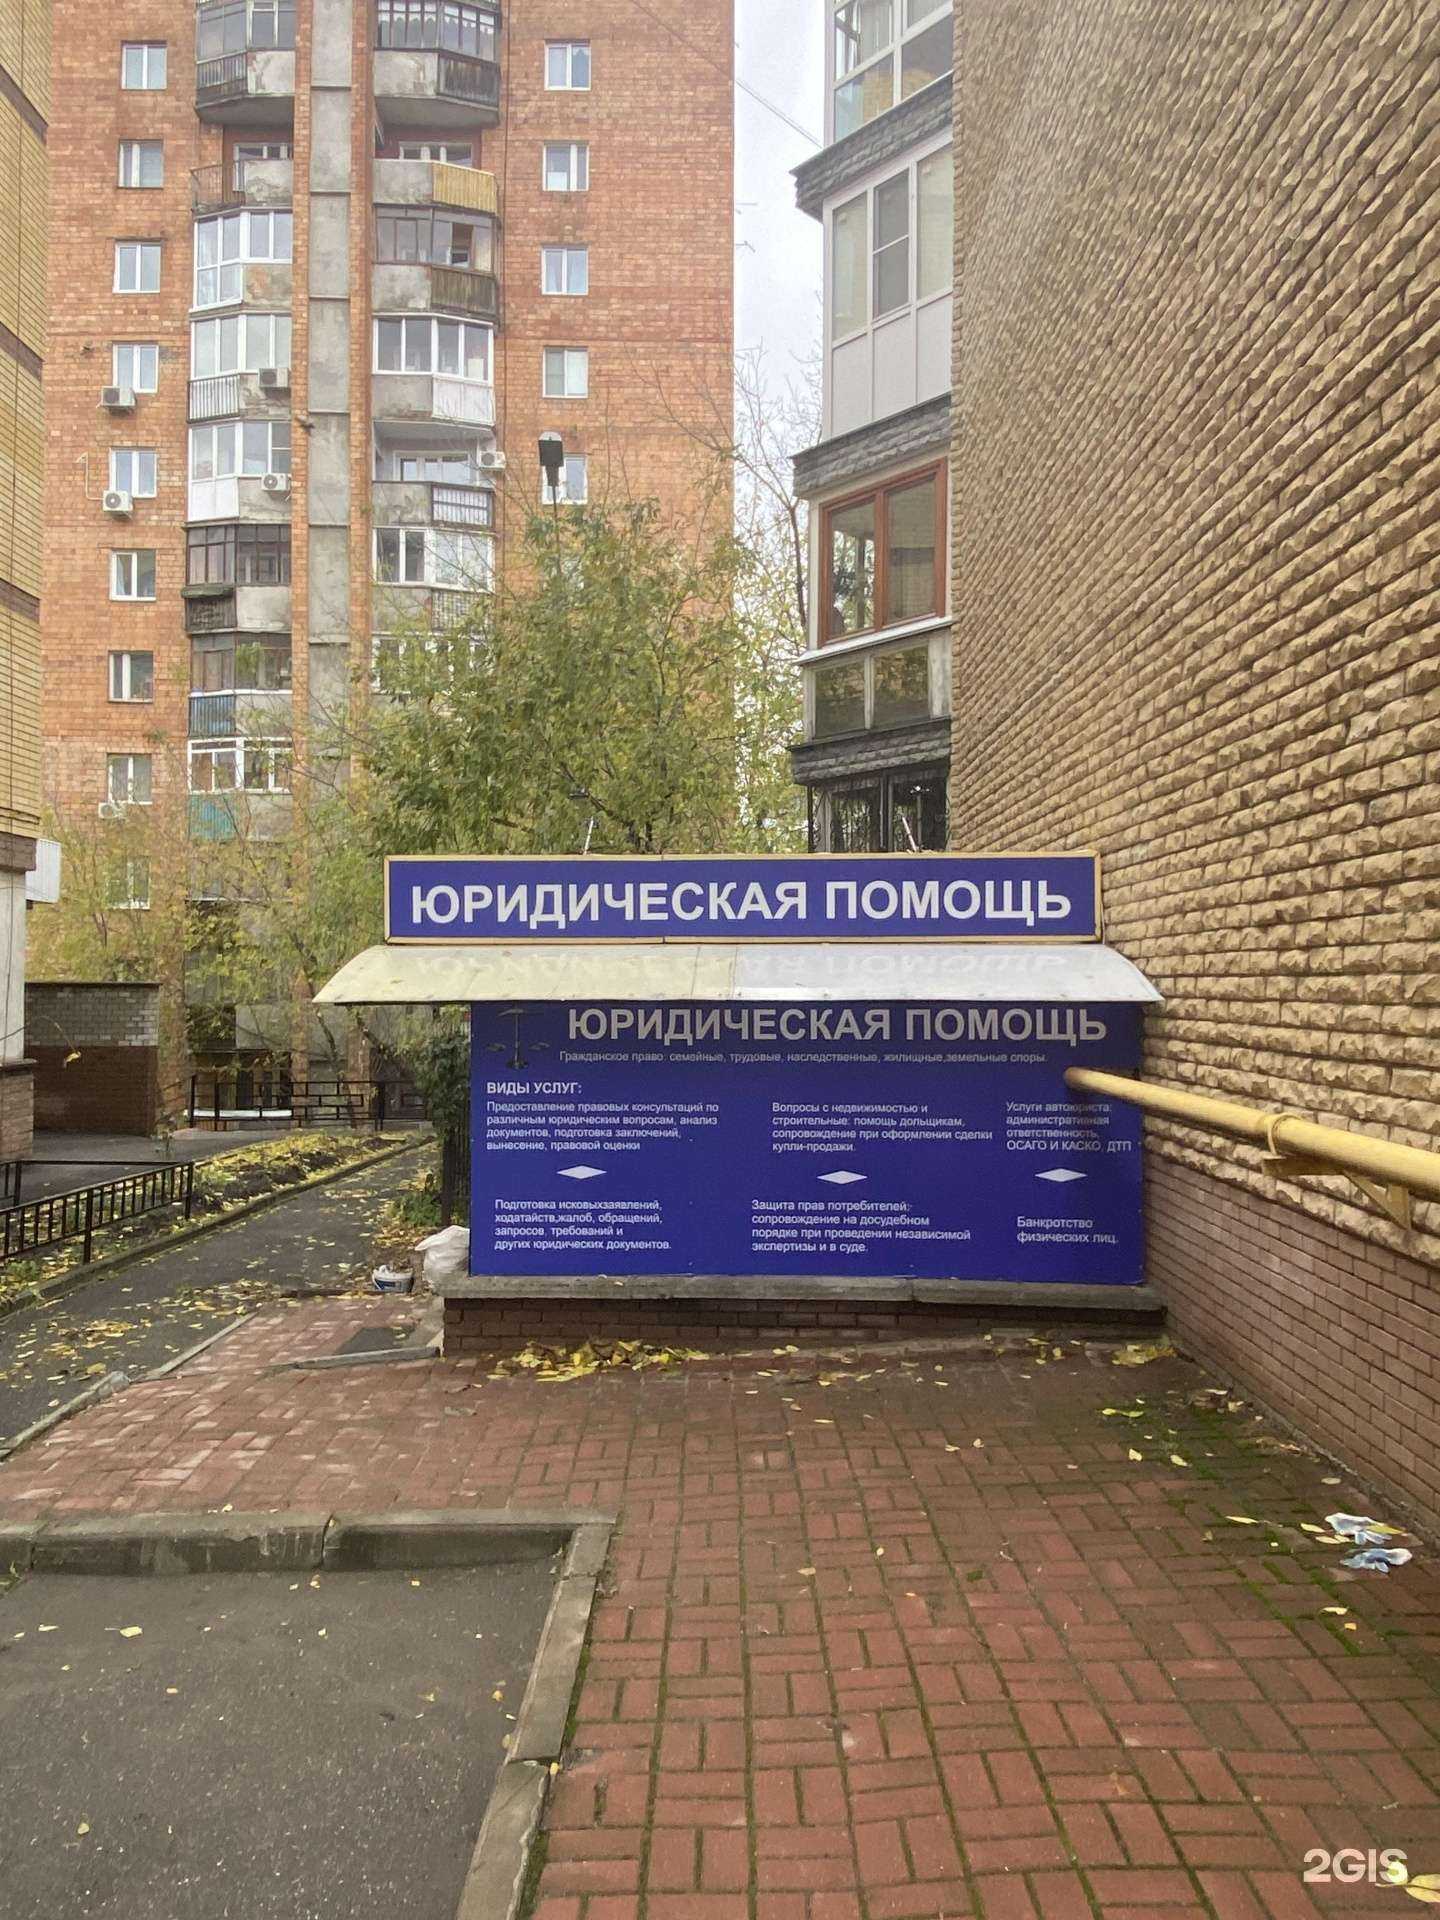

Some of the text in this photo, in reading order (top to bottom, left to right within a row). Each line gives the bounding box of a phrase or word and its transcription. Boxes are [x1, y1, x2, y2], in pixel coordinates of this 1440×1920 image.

[411, 880, 1072, 929] ЮРИДИЧЕСКАЯ ПОМОЩЬ
[568, 1008, 1107, 1047] ЮРИДИЧЕСКАЯ ПОМОЩЬ
[560, 1051, 629, 1063] Гражданское
[669, 1052, 727, 1063] семейные,
[730, 1053, 785, 1064] трудовые,
[787, 1053, 881, 1064] наследственные,
[487, 1082, 582, 1096] ВИДЫ УСЛУГ:
[487, 1101, 719, 1114] Предоставление правовых консультаций по
[772, 1102, 928, 1114] Вопросы с недвижимостью и
[1006, 1101, 1042, 1113] Услуги
[487, 1115, 717, 1126] различным юридическим вопросам, анализ
[854, 1117, 897, 1127] помощь
[899, 1117, 966, 1127] дольщикам,
[487, 1127, 682, 1139] документов, подготовка заключений,
[772, 1129, 993, 1141] сопровождение при оформлении сделки
[487, 1140, 640, 1152] вынесение, правовой оценки
[772, 1143, 856, 1153] купли-продажи.
[1006, 1140, 1047, 1150] ОСАГО
[1049, 1141, 1059, 1150] И
[1106, 1141, 1132, 1153] ДТП
[495, 1199, 556, 1212] Подготовка
[752, 1199, 795, 1212] Защита
[798, 1202, 825, 1212] прав
[598, 1213, 663, 1224] обращений,
[752, 1215, 930, 1227] сопровождение на досудебном
[1017, 1216, 1094, 1229] Банкротство
[551, 1226, 614, 1237] требований
[616, 1228, 624, 1236] и
[752, 1229, 971, 1241] порядке при проведении независимой
[1017, 1231, 1089, 1244] физических
[495, 1241, 672, 1250] других юридических документов.
[752, 1243, 817, 1253] экспертизы
[819, 1243, 827, 1251] и
[830, 1244, 837, 1252] в
